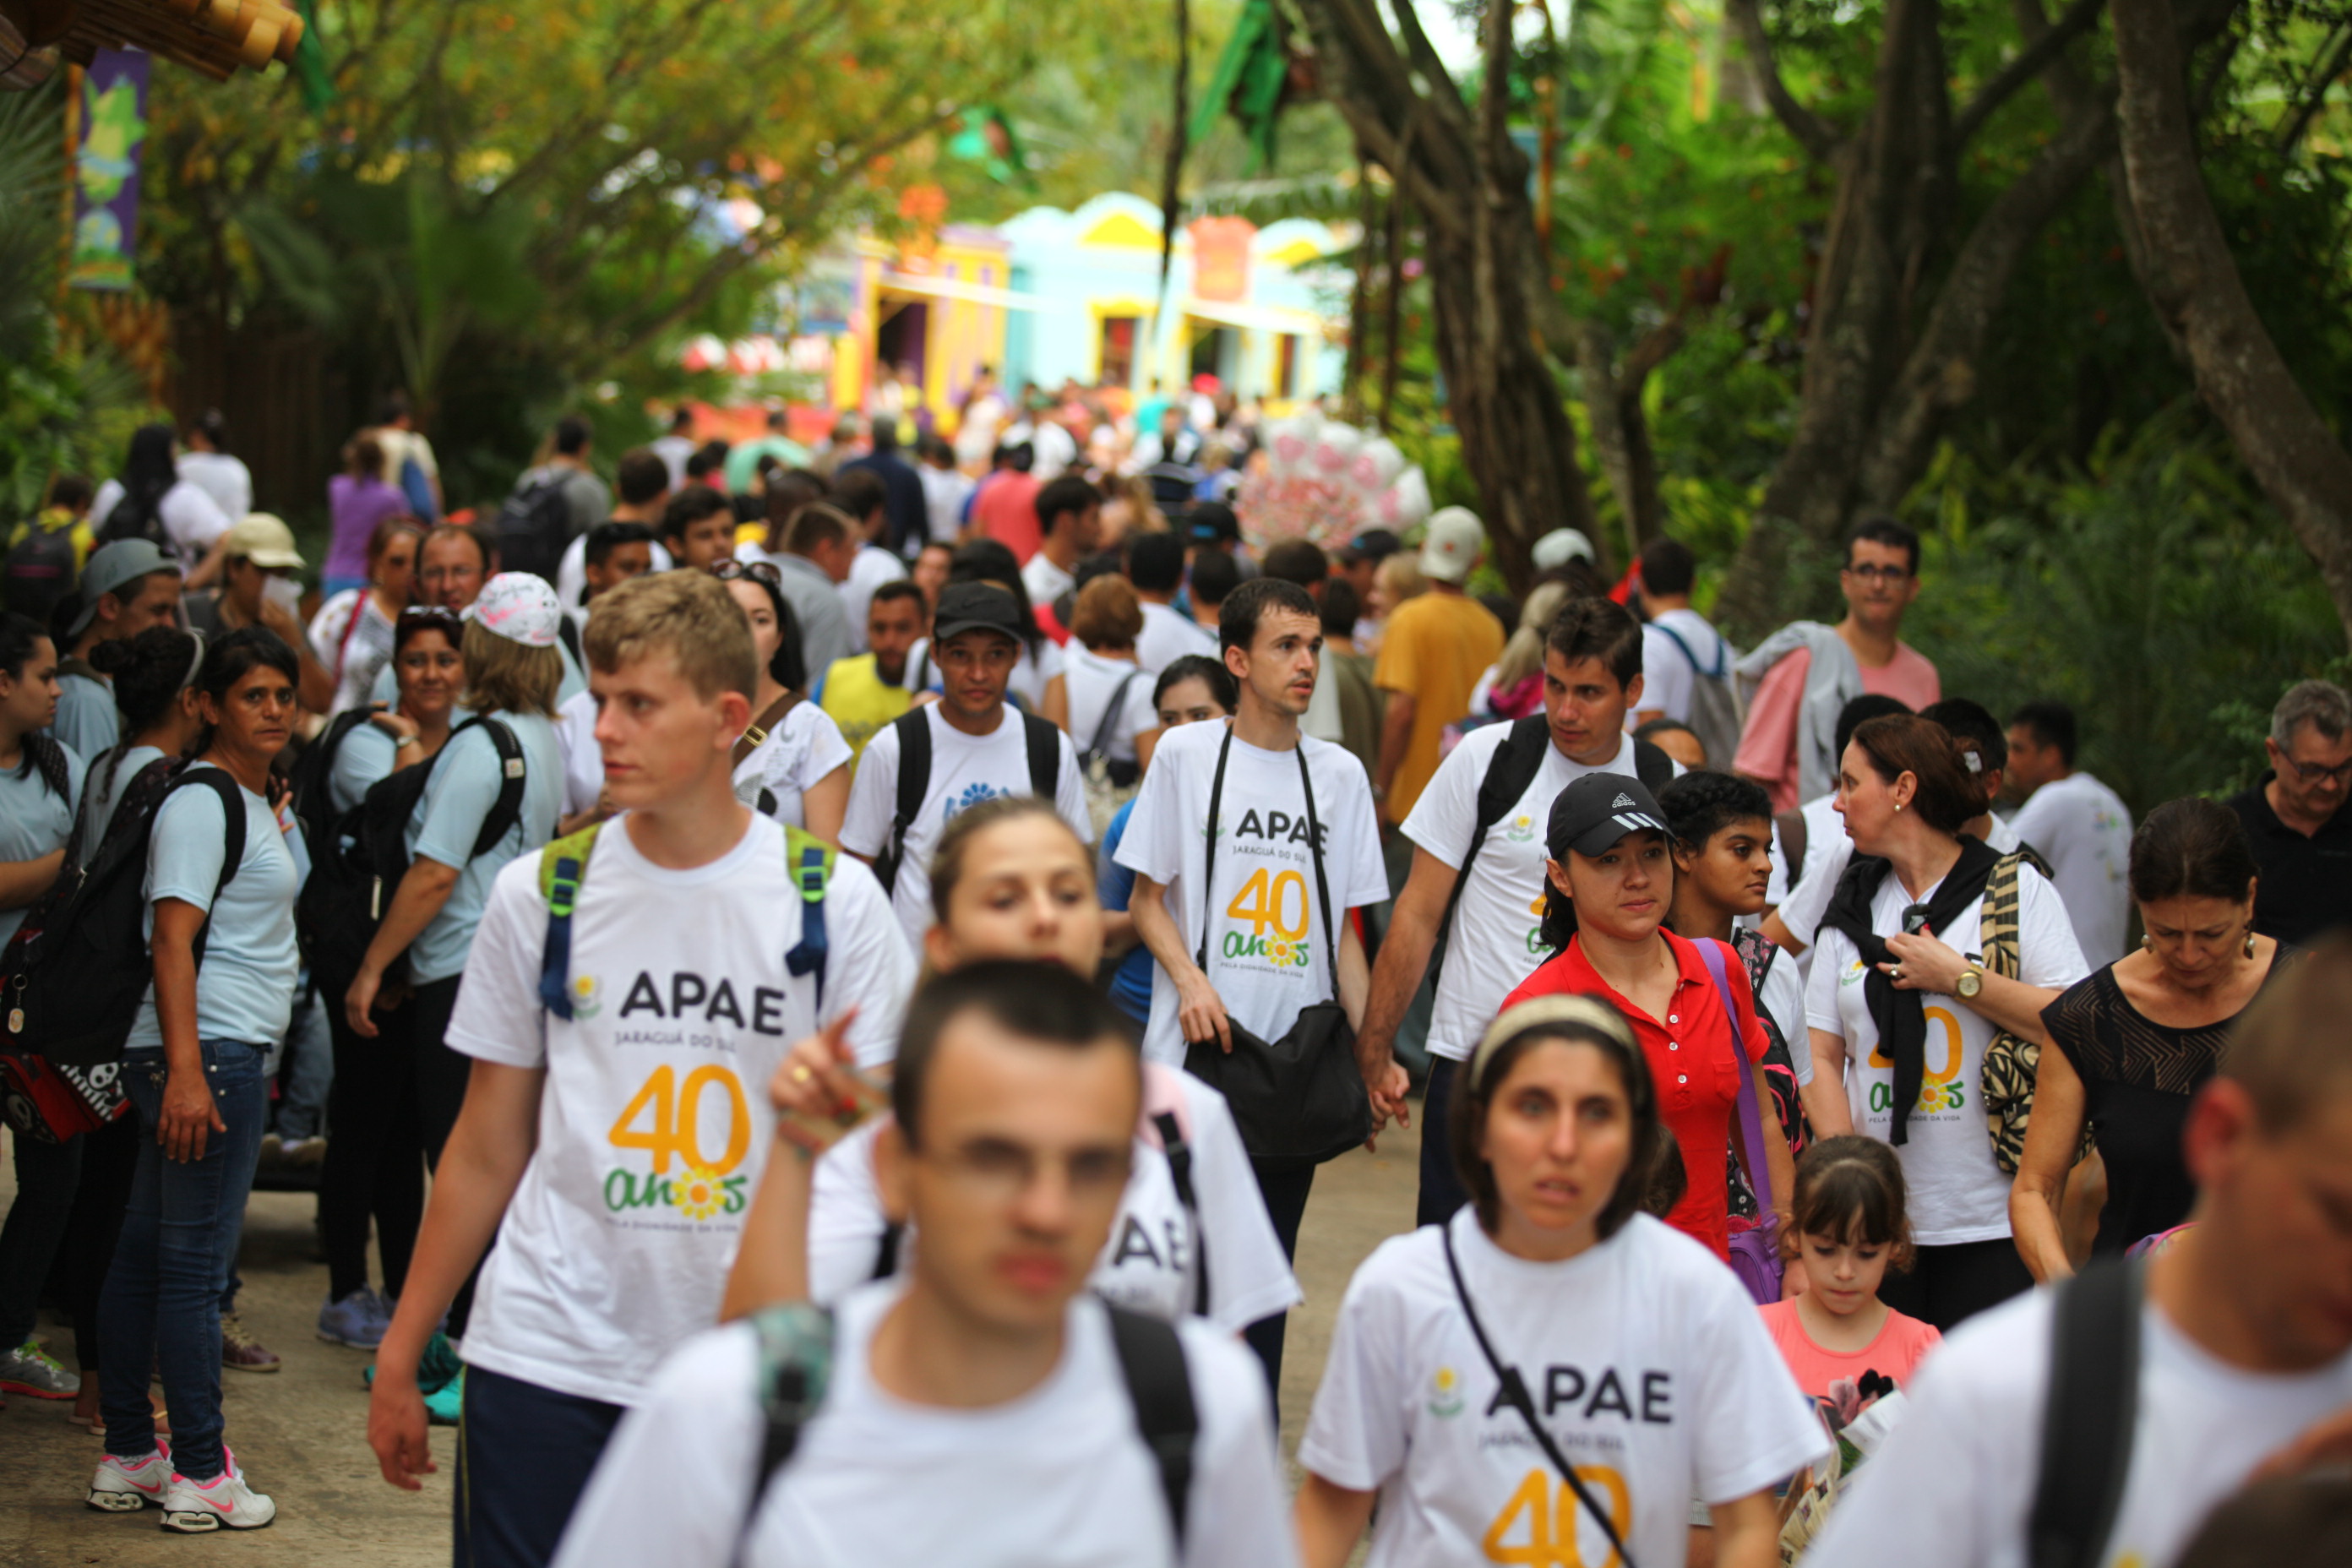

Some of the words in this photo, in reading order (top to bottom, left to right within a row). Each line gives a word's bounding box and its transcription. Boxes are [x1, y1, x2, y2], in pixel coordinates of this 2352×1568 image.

[1278, 850, 1292, 859] DO
[1227, 867, 1310, 942] 40
[619, 970, 786, 1037] APAE
[689, 1033, 713, 1048] DO
[607, 1064, 752, 1178] 40
[1486, 1364, 1672, 1424] APAE
[1481, 1463, 1633, 1568] 40
